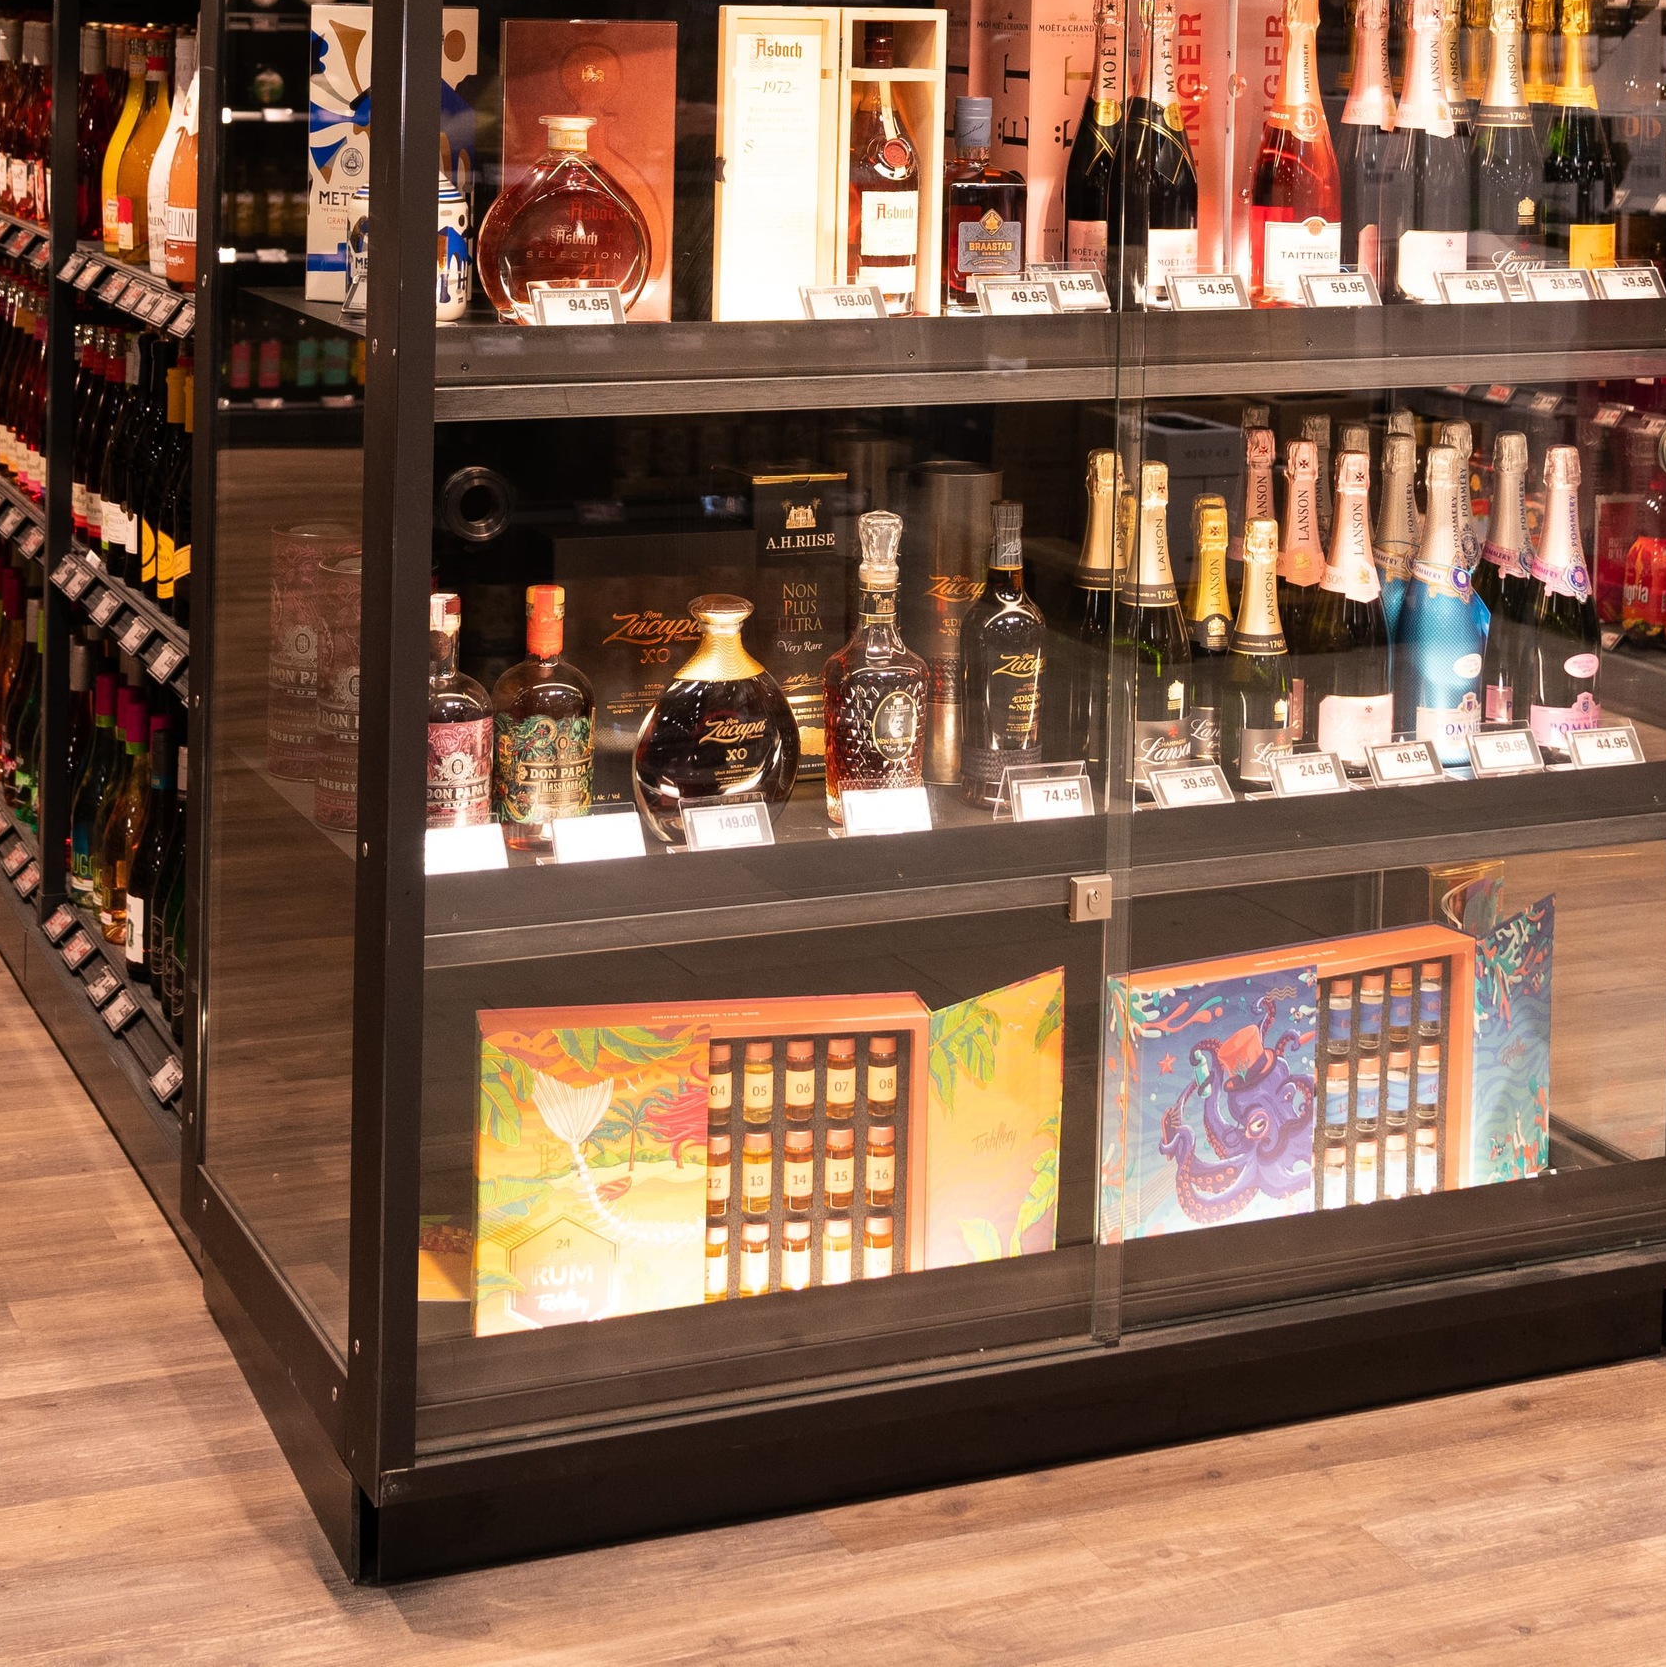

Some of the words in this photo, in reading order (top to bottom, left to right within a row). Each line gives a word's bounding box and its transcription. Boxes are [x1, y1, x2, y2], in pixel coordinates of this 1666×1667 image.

[1038, 23, 1061, 33] MOËT
[1067, 24, 1095, 33] CHAND
[756, 38, 803, 60] Asbach
[1101, 35, 1118, 90] MOËT
[1162, 34, 1176, 94] MOËT
[1303, 43, 1311, 94] TAITTINGER
[1430, 39, 1442, 92] LANSON
[1450, 40, 1461, 91] LANSON
[1507, 43, 1519, 95] LANSON
[761, 81, 792, 95] 1972
[1509, 111, 1527, 121] 1760
[876, 203, 915, 220] Asbach
[968, 240, 1013, 252] BRAASTAD
[526, 250, 622, 260] SELECTION
[1280, 250, 1338, 260] TAITTINGER
[1059, 278, 1094, 292] 64.95
[1198, 282, 1234, 295] 54.95
[1331, 281, 1366, 293] 59.95
[1465, 278, 1498, 292] 49.95
[1551, 277, 1583, 290] 39.95
[833, 294, 872, 307] 159.00
[1011, 289, 1048, 304] 49.95
[568, 298, 610, 312] 94.95
[1460, 466, 1469, 518] POMMERY
[1406, 482, 1414, 534] POMMERY
[1518, 479, 1527, 531] POMMERY
[1298, 489, 1310, 542] LANSON
[1451, 494, 1460, 549] POMMERY
[1569, 494, 1578, 548] POMMERY
[1353, 502, 1365, 556] LANSON
[765, 533, 836, 550] A.H.RIISE
[1156, 518, 1168, 573] LANSON
[925, 575, 985, 603] Zacap
[1210, 558, 1221, 607] LANSON
[783, 582, 818, 599] NON
[1156, 589, 1174, 600] 1760
[1265, 571, 1277, 625] LANSON
[643, 610, 663, 620] Ron
[783, 600, 817, 615] PLUS
[777, 616, 823, 632] ULTRA
[777, 640, 802, 654] Very
[803, 641, 823, 652] Rare
[640, 647, 670, 664] XO
[699, 719, 766, 745] Zacapa
[1495, 739, 1528, 754] 59.95
[1595, 736, 1629, 750] 44.95
[725, 748, 748, 762] XO
[1396, 750, 1429, 765] 49.95
[529, 768, 557, 779] DON
[560, 765, 587, 778] PAPA
[1299, 762, 1333, 777] 24.95
[1180, 775, 1217, 790] 39.95
[454, 786, 484, 800] PAPA
[1042, 787, 1080, 803] 74.95
[717, 814, 757, 830] 149.00
[710, 1085, 726, 1097] 04
[752, 1085, 767, 1097] 05
[795, 1083, 811, 1094] 06
[834, 1081, 849, 1092] 07
[878, 1078, 894, 1090] 08
[750, 1175, 764, 1187] 13
[792, 1174, 807, 1185] 14
[834, 1171, 848, 1182] 15
[874, 1169, 889, 1181] 16
[555, 1239, 571, 1250] 24
[533, 1263, 593, 1286] RUM
